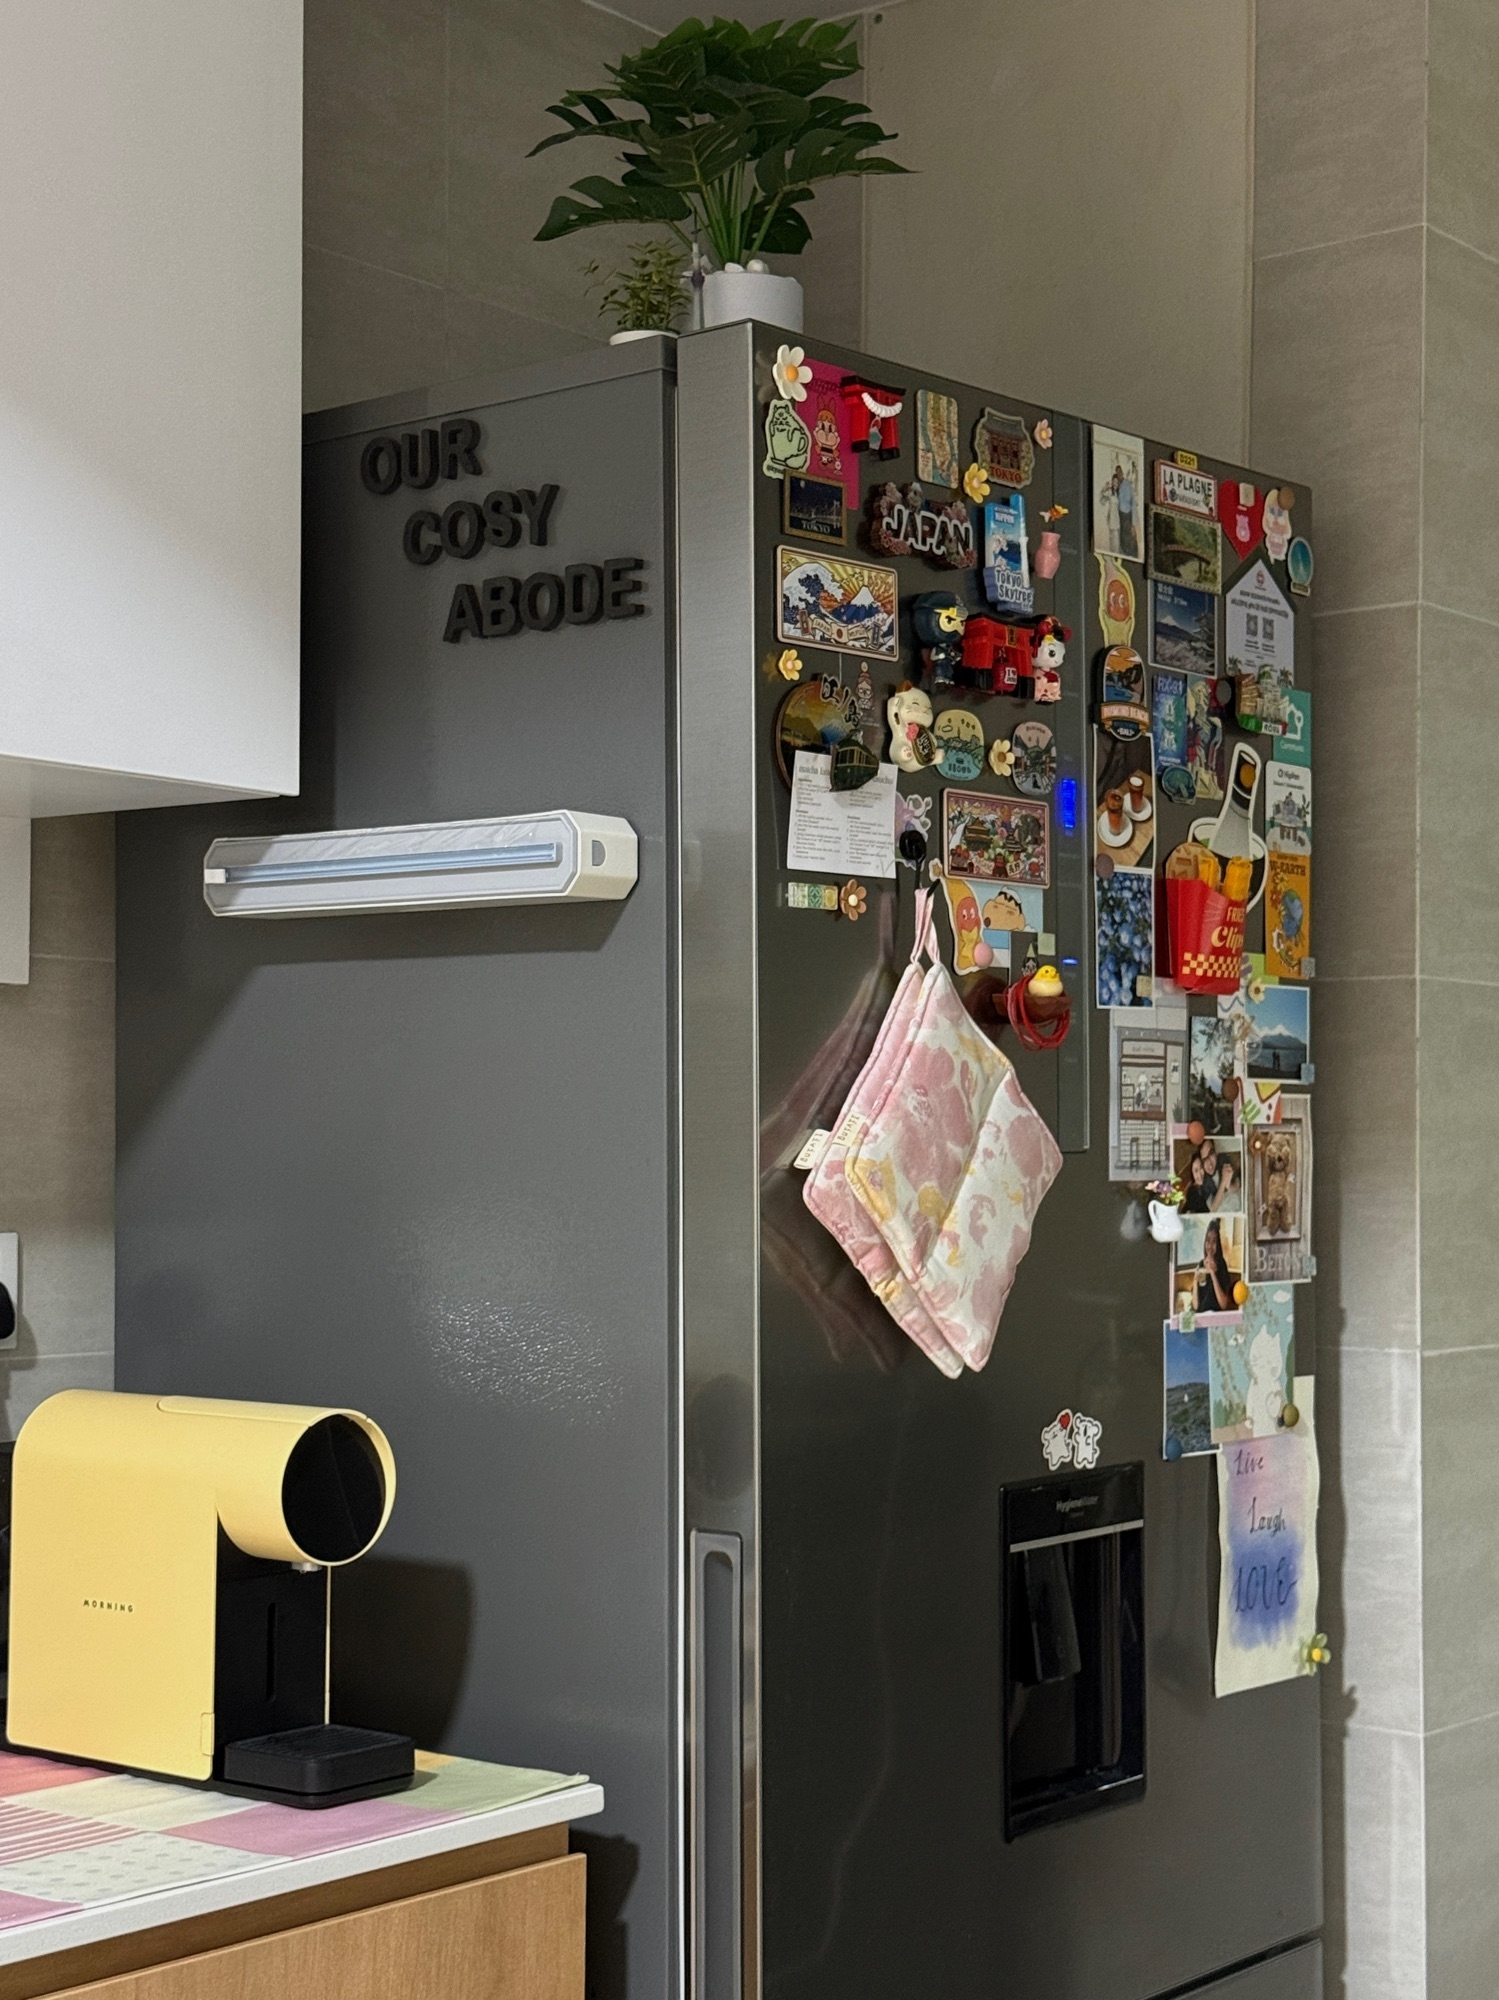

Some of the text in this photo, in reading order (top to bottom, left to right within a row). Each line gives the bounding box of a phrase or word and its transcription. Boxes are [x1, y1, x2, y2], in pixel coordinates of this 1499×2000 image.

[361, 419, 483, 496] OUR
[990, 466, 1022, 483] TOKYO
[1163, 469, 1212, 498] LA PLAGNE
[403, 483, 561, 566] COSY
[801, 520, 831, 533] TOKYO
[883, 504, 973, 557] JAPAN
[995, 568, 1022, 588] Tokyo
[443, 558, 646, 643] ABODE
[998, 585, 1034, 606] Skytree
[1235, 1448, 1264, 1476] Live
[1248, 1497, 1287, 1537] Laugh
[83, 1599, 134, 1613] MORNING
